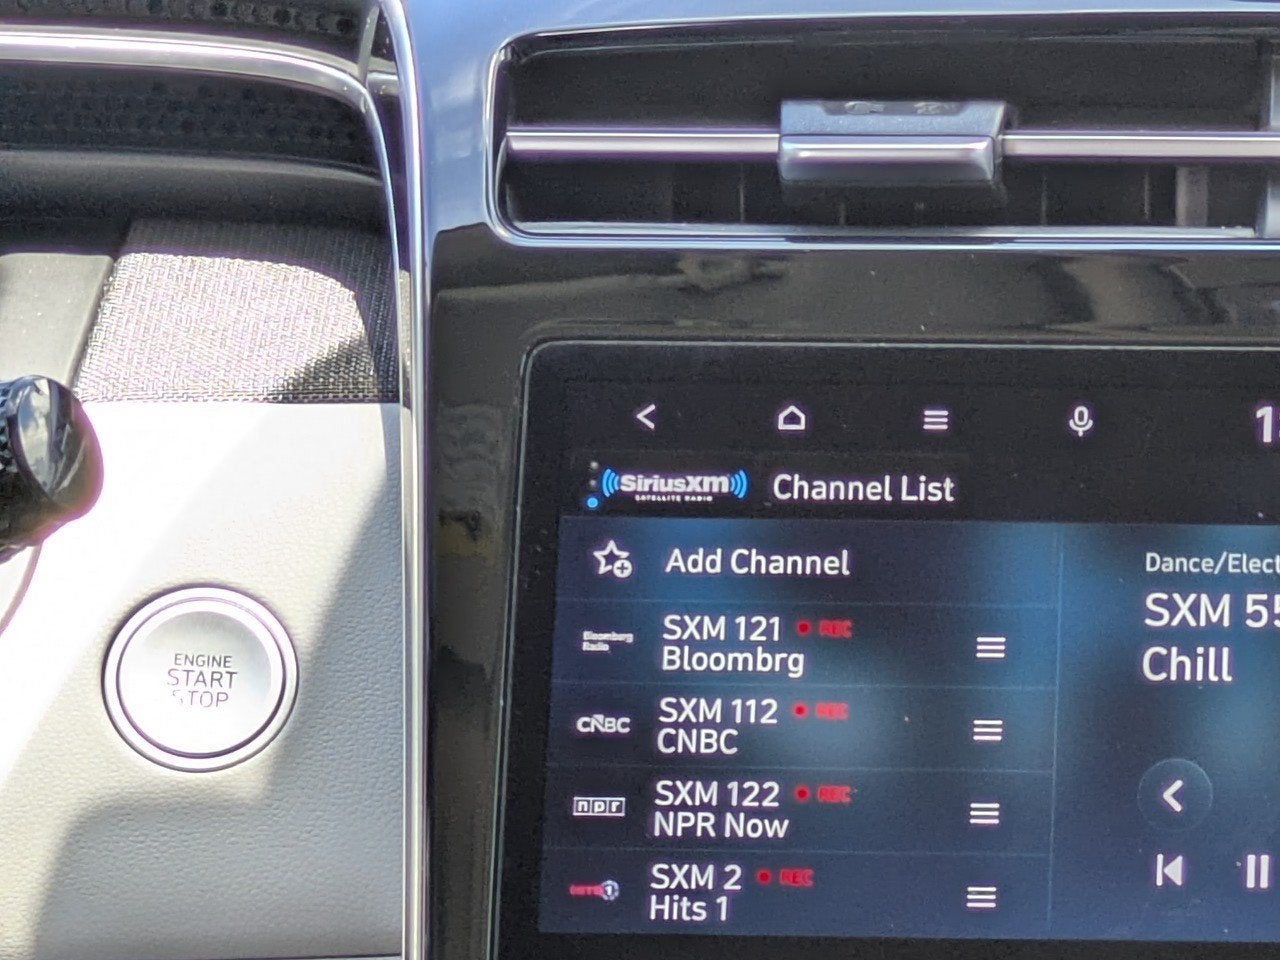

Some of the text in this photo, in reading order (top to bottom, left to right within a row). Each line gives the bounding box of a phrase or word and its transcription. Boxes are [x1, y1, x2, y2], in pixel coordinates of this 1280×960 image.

[772, 474, 956, 502] Channel List
[665, 548, 851, 577] Add Channel
[1143, 592, 1231, 628] SXM
[662, 614, 726, 641] SXM
[734, 615, 781, 641] 121
[173, 653, 233, 668] ENGINE
[661, 645, 805, 679] Bloombrg
[1142, 646, 1233, 682] Chill
[167, 668, 238, 689] START
[173, 690, 229, 708] STOP
[658, 698, 849, 724] SXM 112 REC
[656, 728, 739, 756] CNBC
[654, 781, 850, 808] SXM 122 REC
[653, 813, 789, 838] NPR Now
[650, 863, 815, 891] SXM 2 REC
[649, 895, 728, 921] Hits 1
